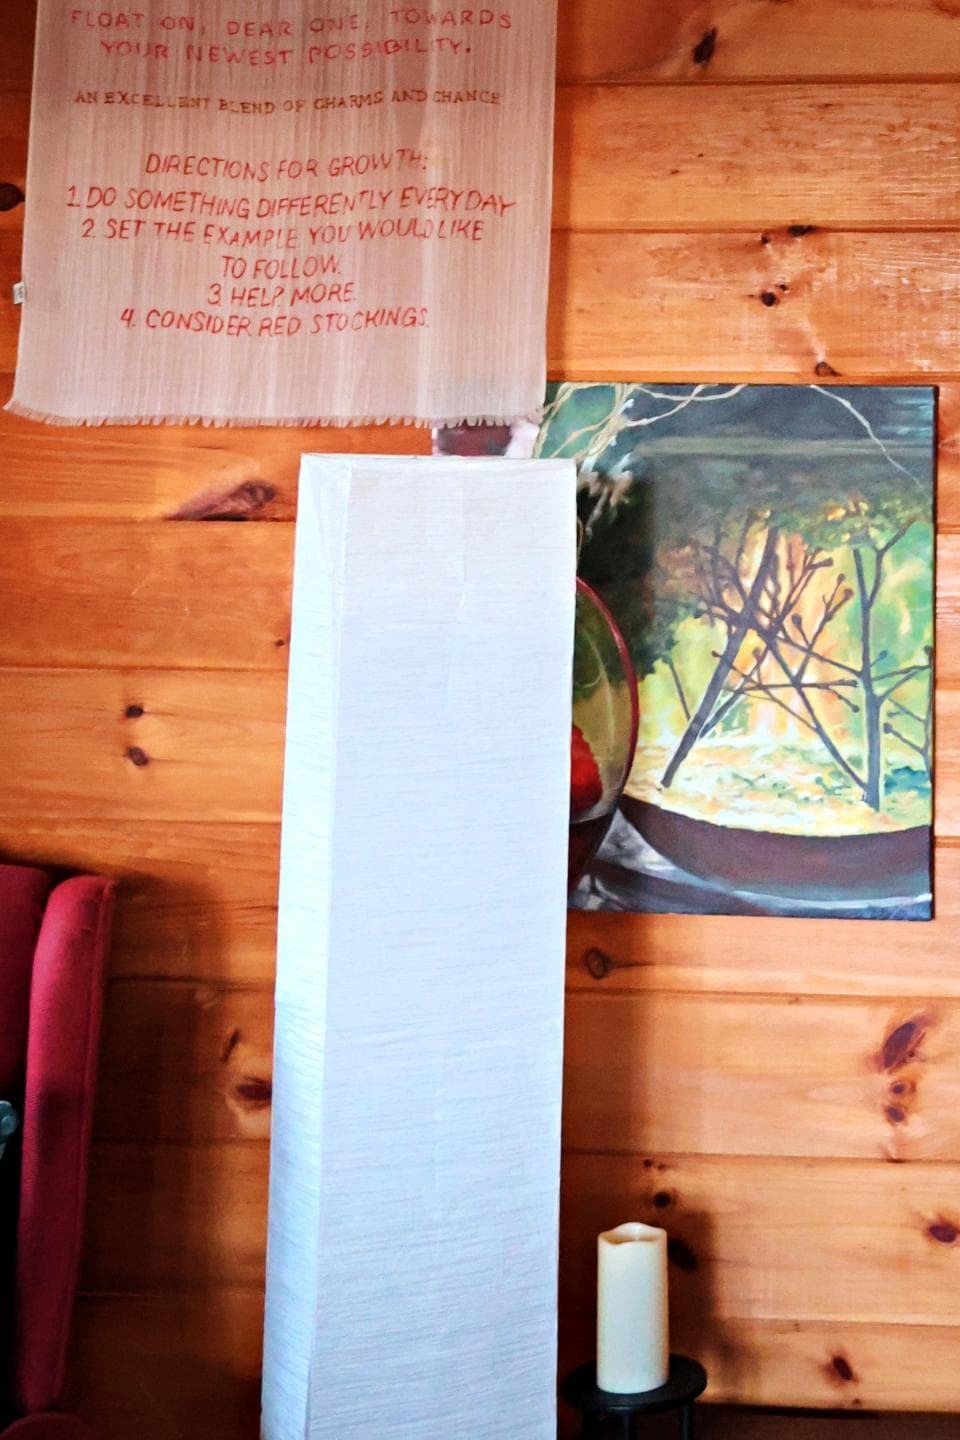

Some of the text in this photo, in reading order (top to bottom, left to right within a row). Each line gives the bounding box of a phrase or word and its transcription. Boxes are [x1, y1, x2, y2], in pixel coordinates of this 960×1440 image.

[70, 9, 144, 29] FLOAT
[227, 20, 292, 38] DEAR
[390, 8, 512, 30] TOWARDS
[100, 37, 472, 66] YOUR NEWEST POSSIBILTY.
[74, 89, 501, 115] AN EXCELLENT BLEND OF CHARMS AND CHANCE
[144, 148, 428, 183] DIRECTIONS FOR GROWTH:
[86, 186, 117, 209] DO
[125, 188, 251, 220] SOMETHING
[256, 189, 393, 219] DIFFERENTLY
[81, 217, 485, 249] 2. SET THE EXAMPLE YOU WOULD LIKE
[222, 254, 342, 281] TO FOLLOW.
[120, 308, 136, 328] 4.
[146, 308, 251, 337] CONSIDER
[258, 315, 302, 338] RED
